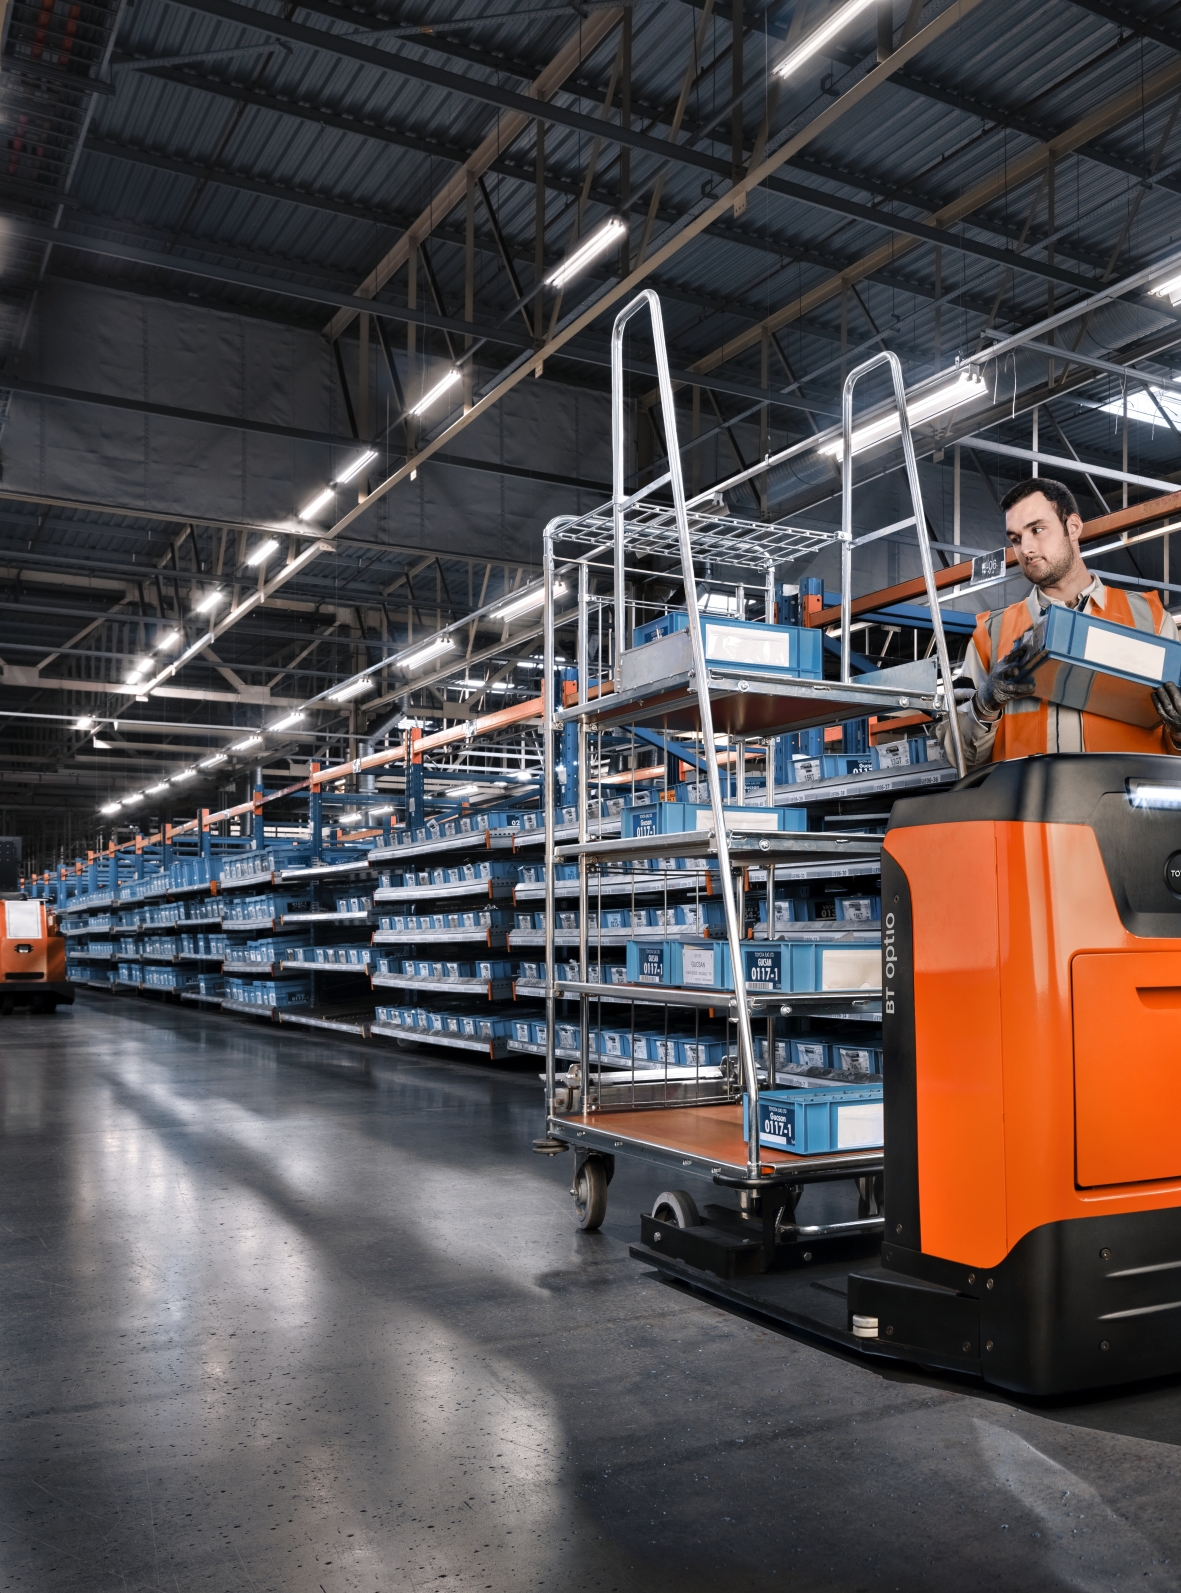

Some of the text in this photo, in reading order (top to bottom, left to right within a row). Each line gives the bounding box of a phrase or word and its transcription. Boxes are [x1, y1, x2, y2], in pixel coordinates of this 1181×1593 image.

[637, 825, 655, 837] 0117-1
[644, 963, 663, 975] 0117-1
[751, 967, 778, 981] 0117-1
[885, 987, 895, 1014] BT
[770, 1112, 786, 1122] Gucsan
[765, 1120, 791, 1137] 0117-1
